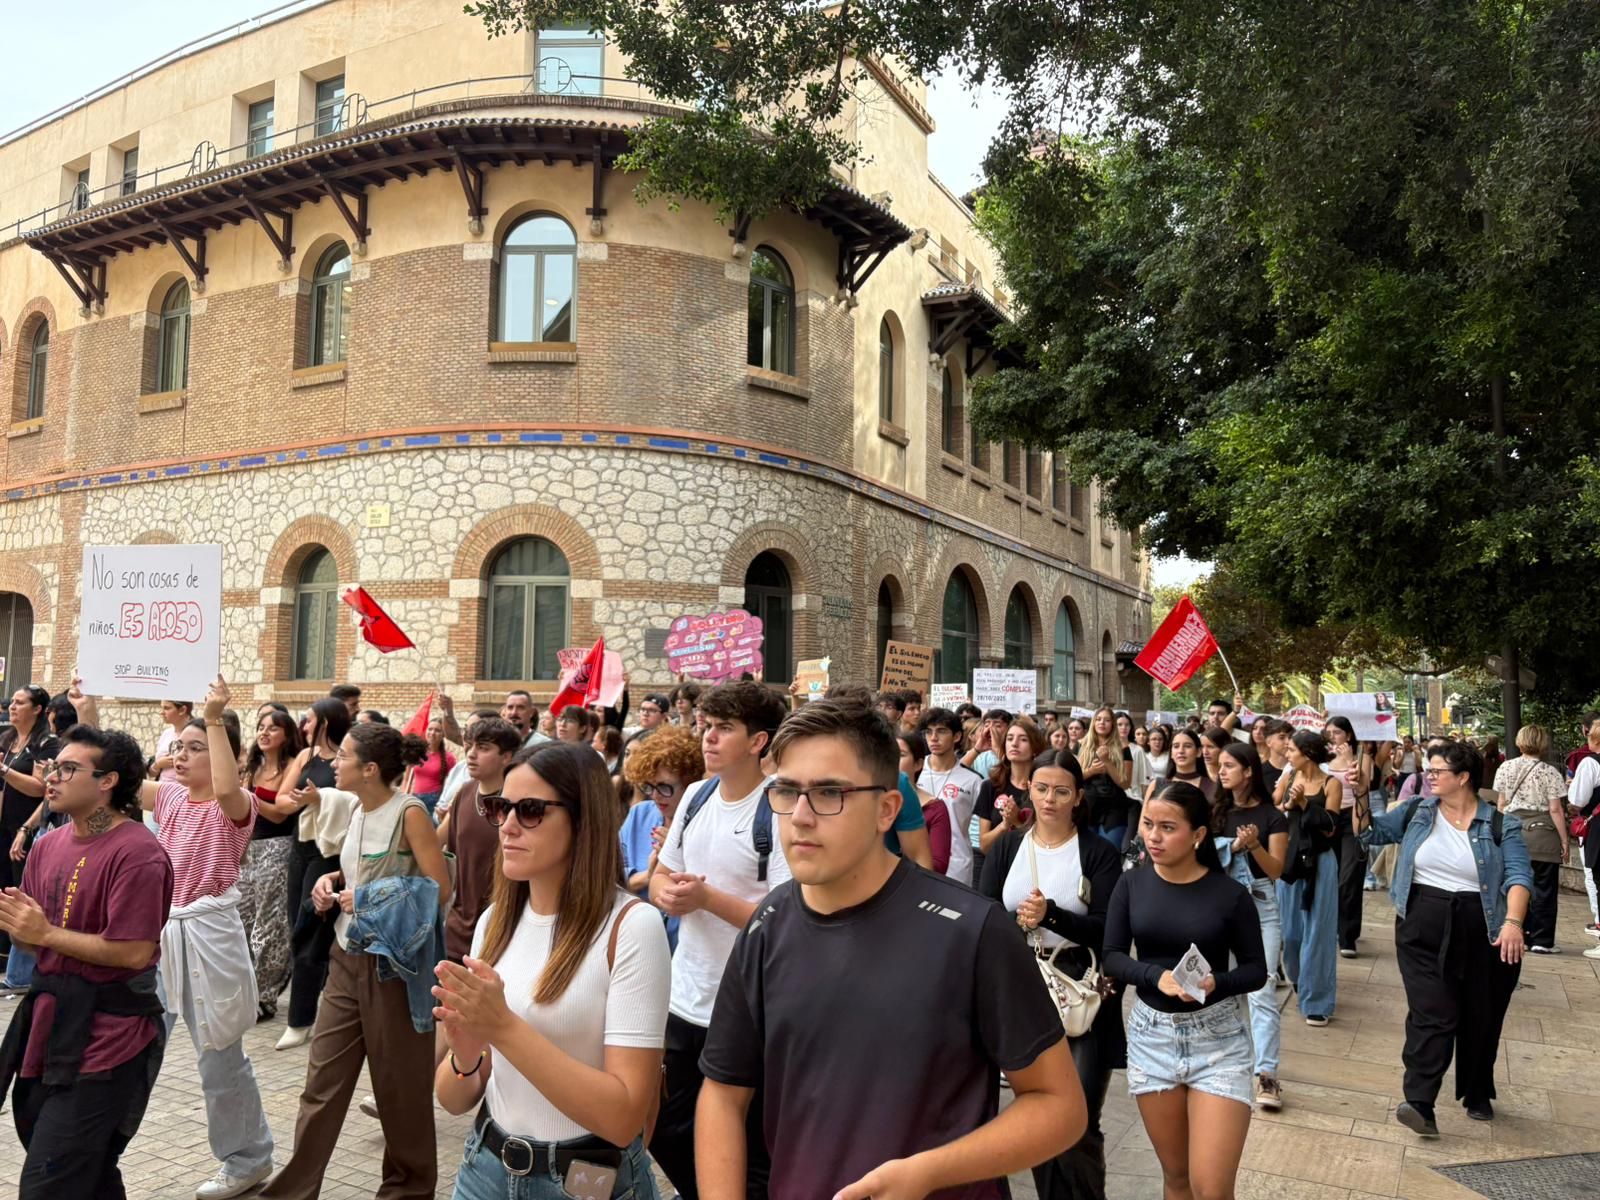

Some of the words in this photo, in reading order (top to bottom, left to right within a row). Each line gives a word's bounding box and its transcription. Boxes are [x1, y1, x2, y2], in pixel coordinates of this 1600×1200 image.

[92, 553, 114, 590] No
[121, 571, 145, 589] son
[148, 572, 180, 589] cosas
[186, 563, 200, 588] de
[119, 602, 145, 639] ES
[148, 601, 203, 644] ACOSO
[114, 664, 131, 675] STOP
[137, 665, 169, 676] BULLYING
[1149, 621, 1198, 678] IZQUIERDA
[1160, 625, 1208, 684] REVOLUCIONA
